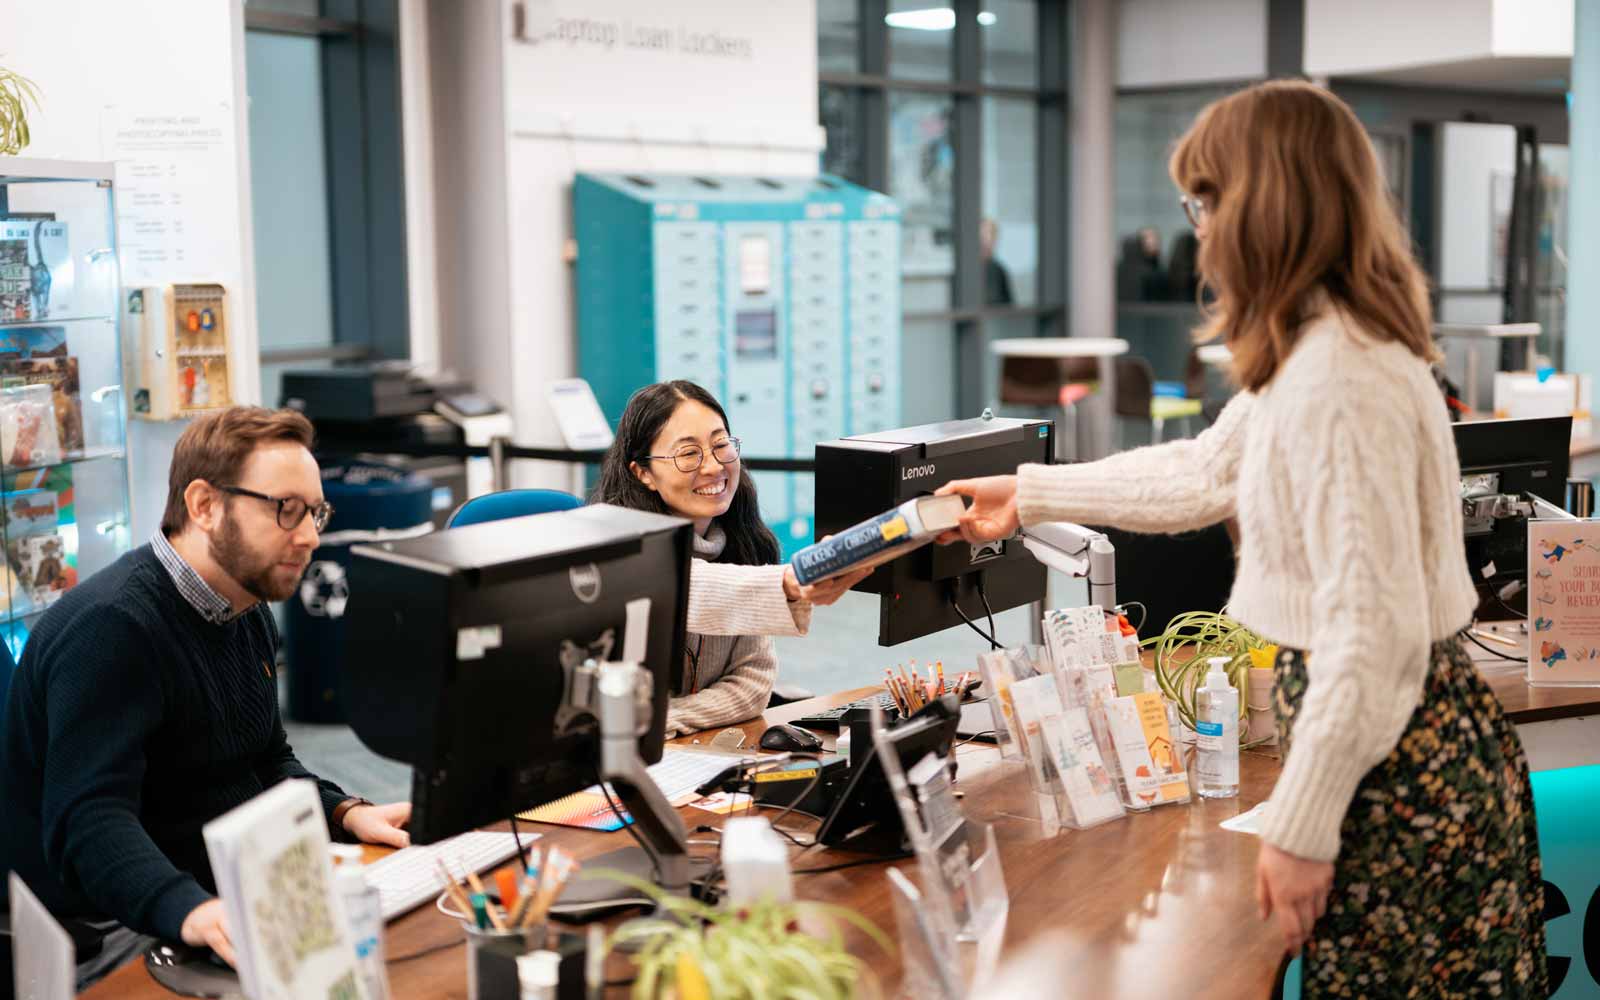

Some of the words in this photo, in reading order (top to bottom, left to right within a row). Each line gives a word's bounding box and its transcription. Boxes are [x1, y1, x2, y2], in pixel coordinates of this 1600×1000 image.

[902, 464, 936, 480] Lenovo
[800, 544, 837, 569] DICKENS
[1573, 566, 1600, 577] SHAR
[1560, 580, 1585, 592] YOUR
[1567, 595, 1600, 607] REVIEW
